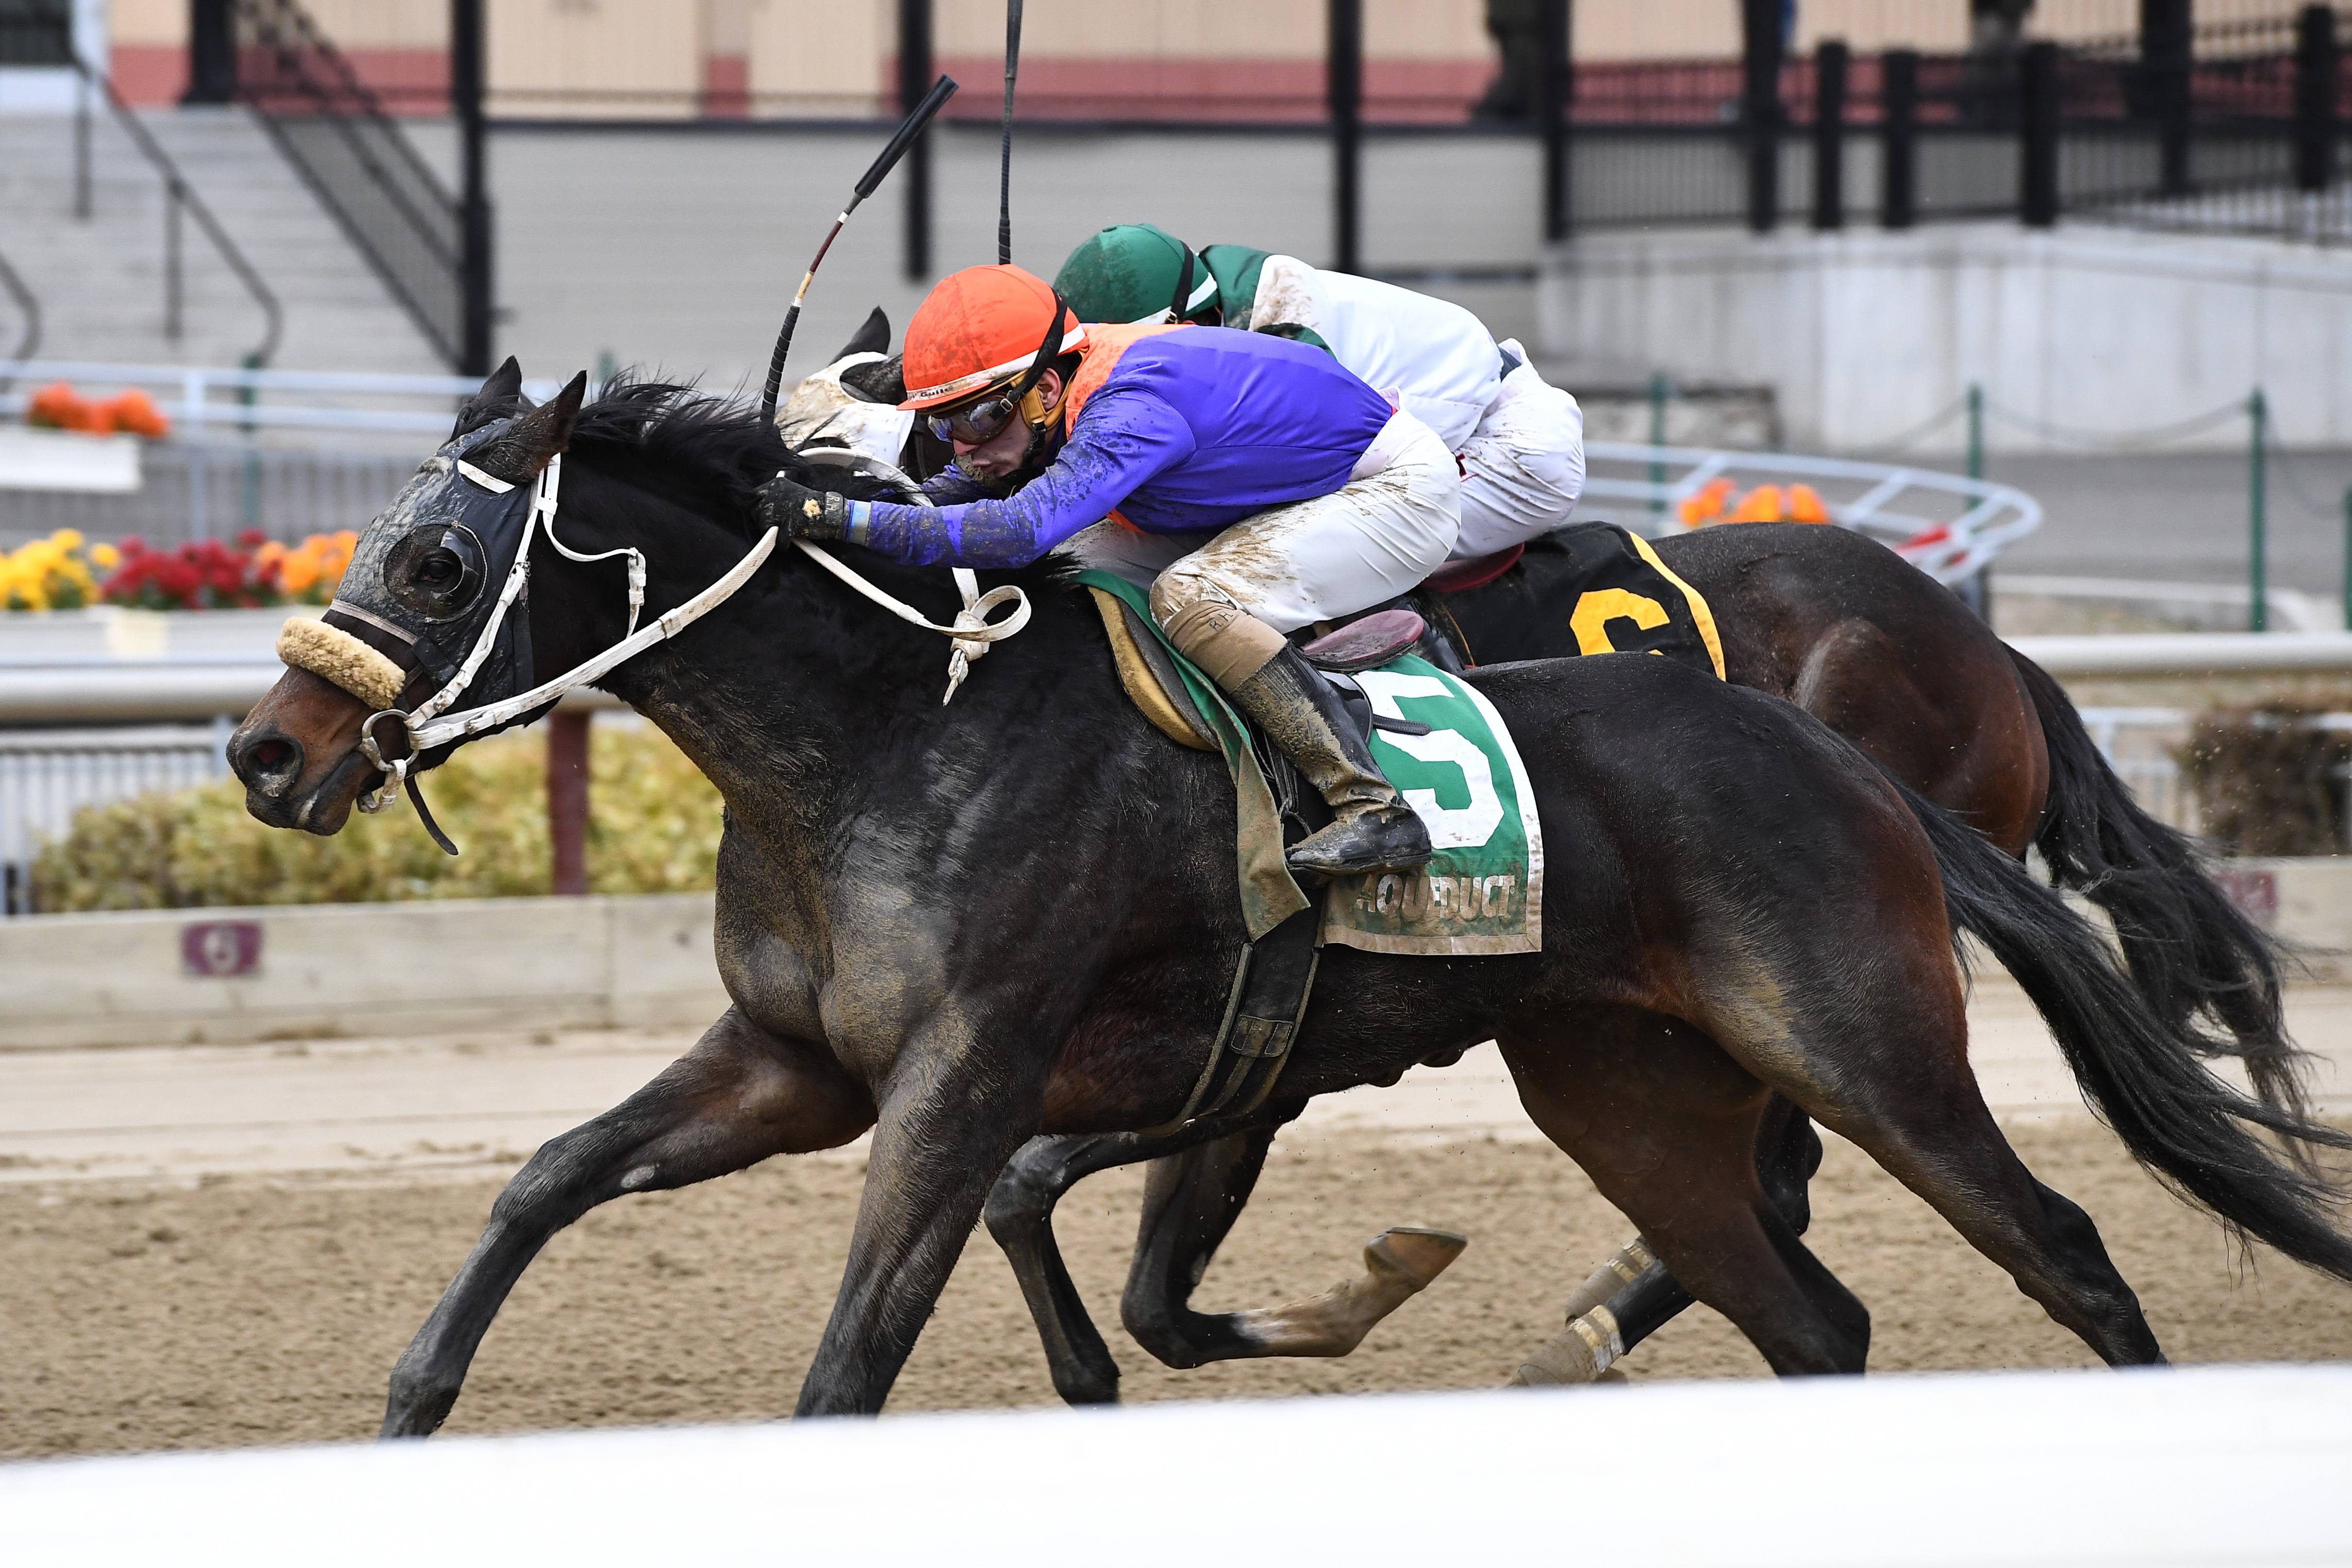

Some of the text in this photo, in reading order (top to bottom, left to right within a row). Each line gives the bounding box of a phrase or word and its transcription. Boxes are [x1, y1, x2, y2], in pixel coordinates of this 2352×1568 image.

[1350, 670, 1505, 850] 5
[1355, 874, 1515, 921] AQUEDUCT
[204, 926, 240, 972] 6
